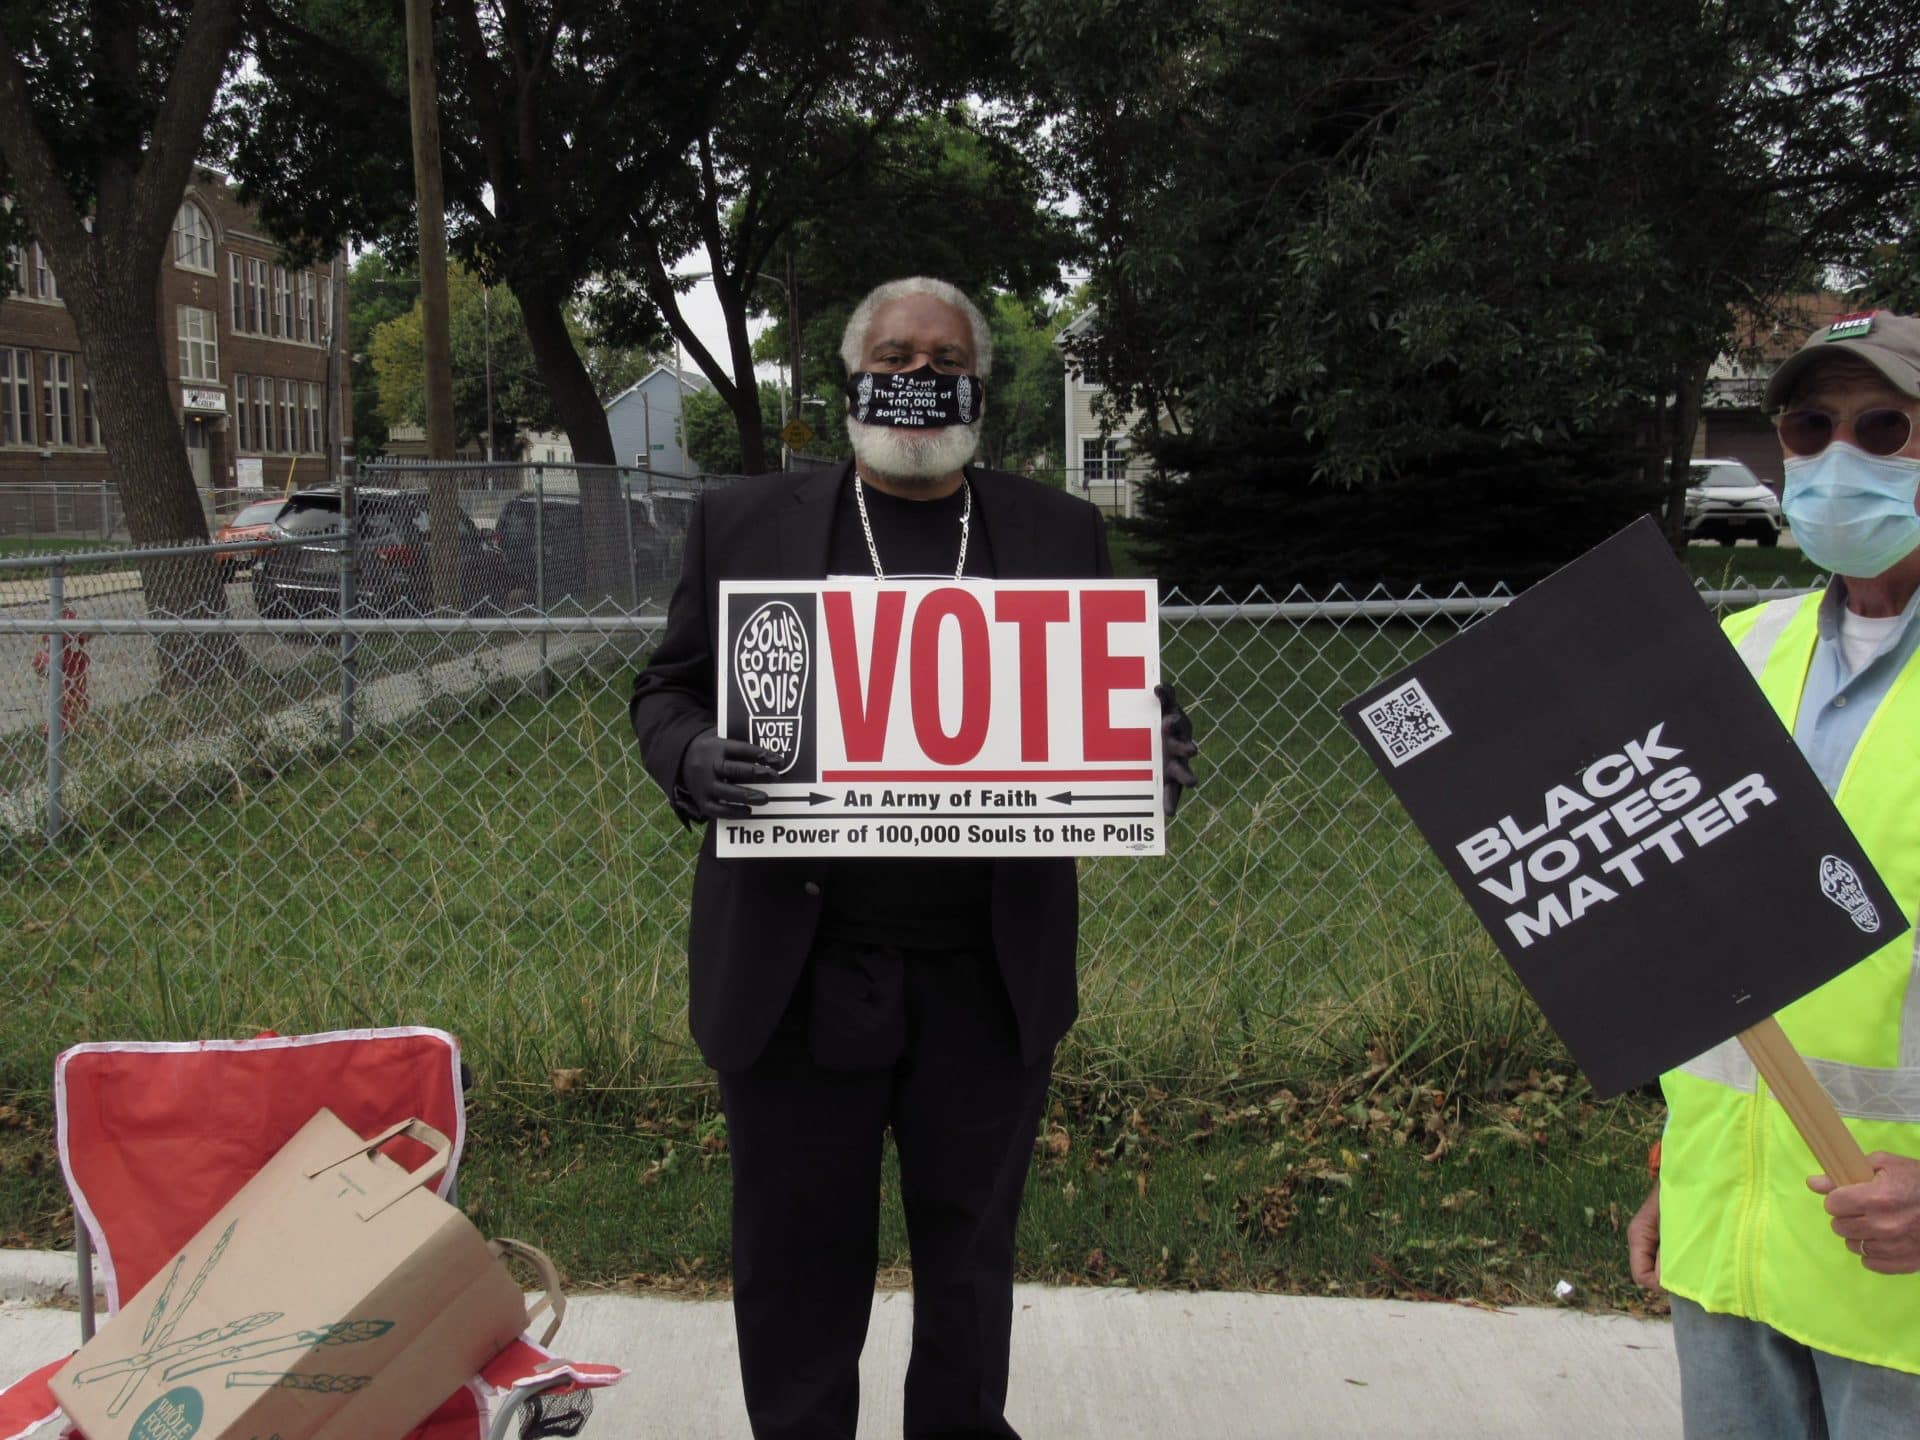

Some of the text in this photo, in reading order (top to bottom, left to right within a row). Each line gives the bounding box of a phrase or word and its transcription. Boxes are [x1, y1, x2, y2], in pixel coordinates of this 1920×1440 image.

[892, 374, 937, 388] An Army
[874, 389, 952, 400] The Power of
[888, 398, 937, 408] 100,000
[875, 408, 947, 418] Souls to the
[894, 415, 925, 425] Polls
[743, 610, 802, 652] Souls
[740, 648, 803, 672] to the
[822, 587, 1152, 766] VOTE
[742, 672, 800, 715] Polls
[756, 721, 793, 737] VOTE
[760, 737, 791, 752] NOV.
[844, 790, 1038, 810] An Army of Faith
[1455, 721, 1684, 875] BLACK
[726, 824, 1155, 846] The Power of 100,000 Souls to the Polls
[1478, 766, 1701, 905] VOTES
[1504, 773, 1778, 948] MATTER
[155, 1397, 193, 1439] WHOLE
